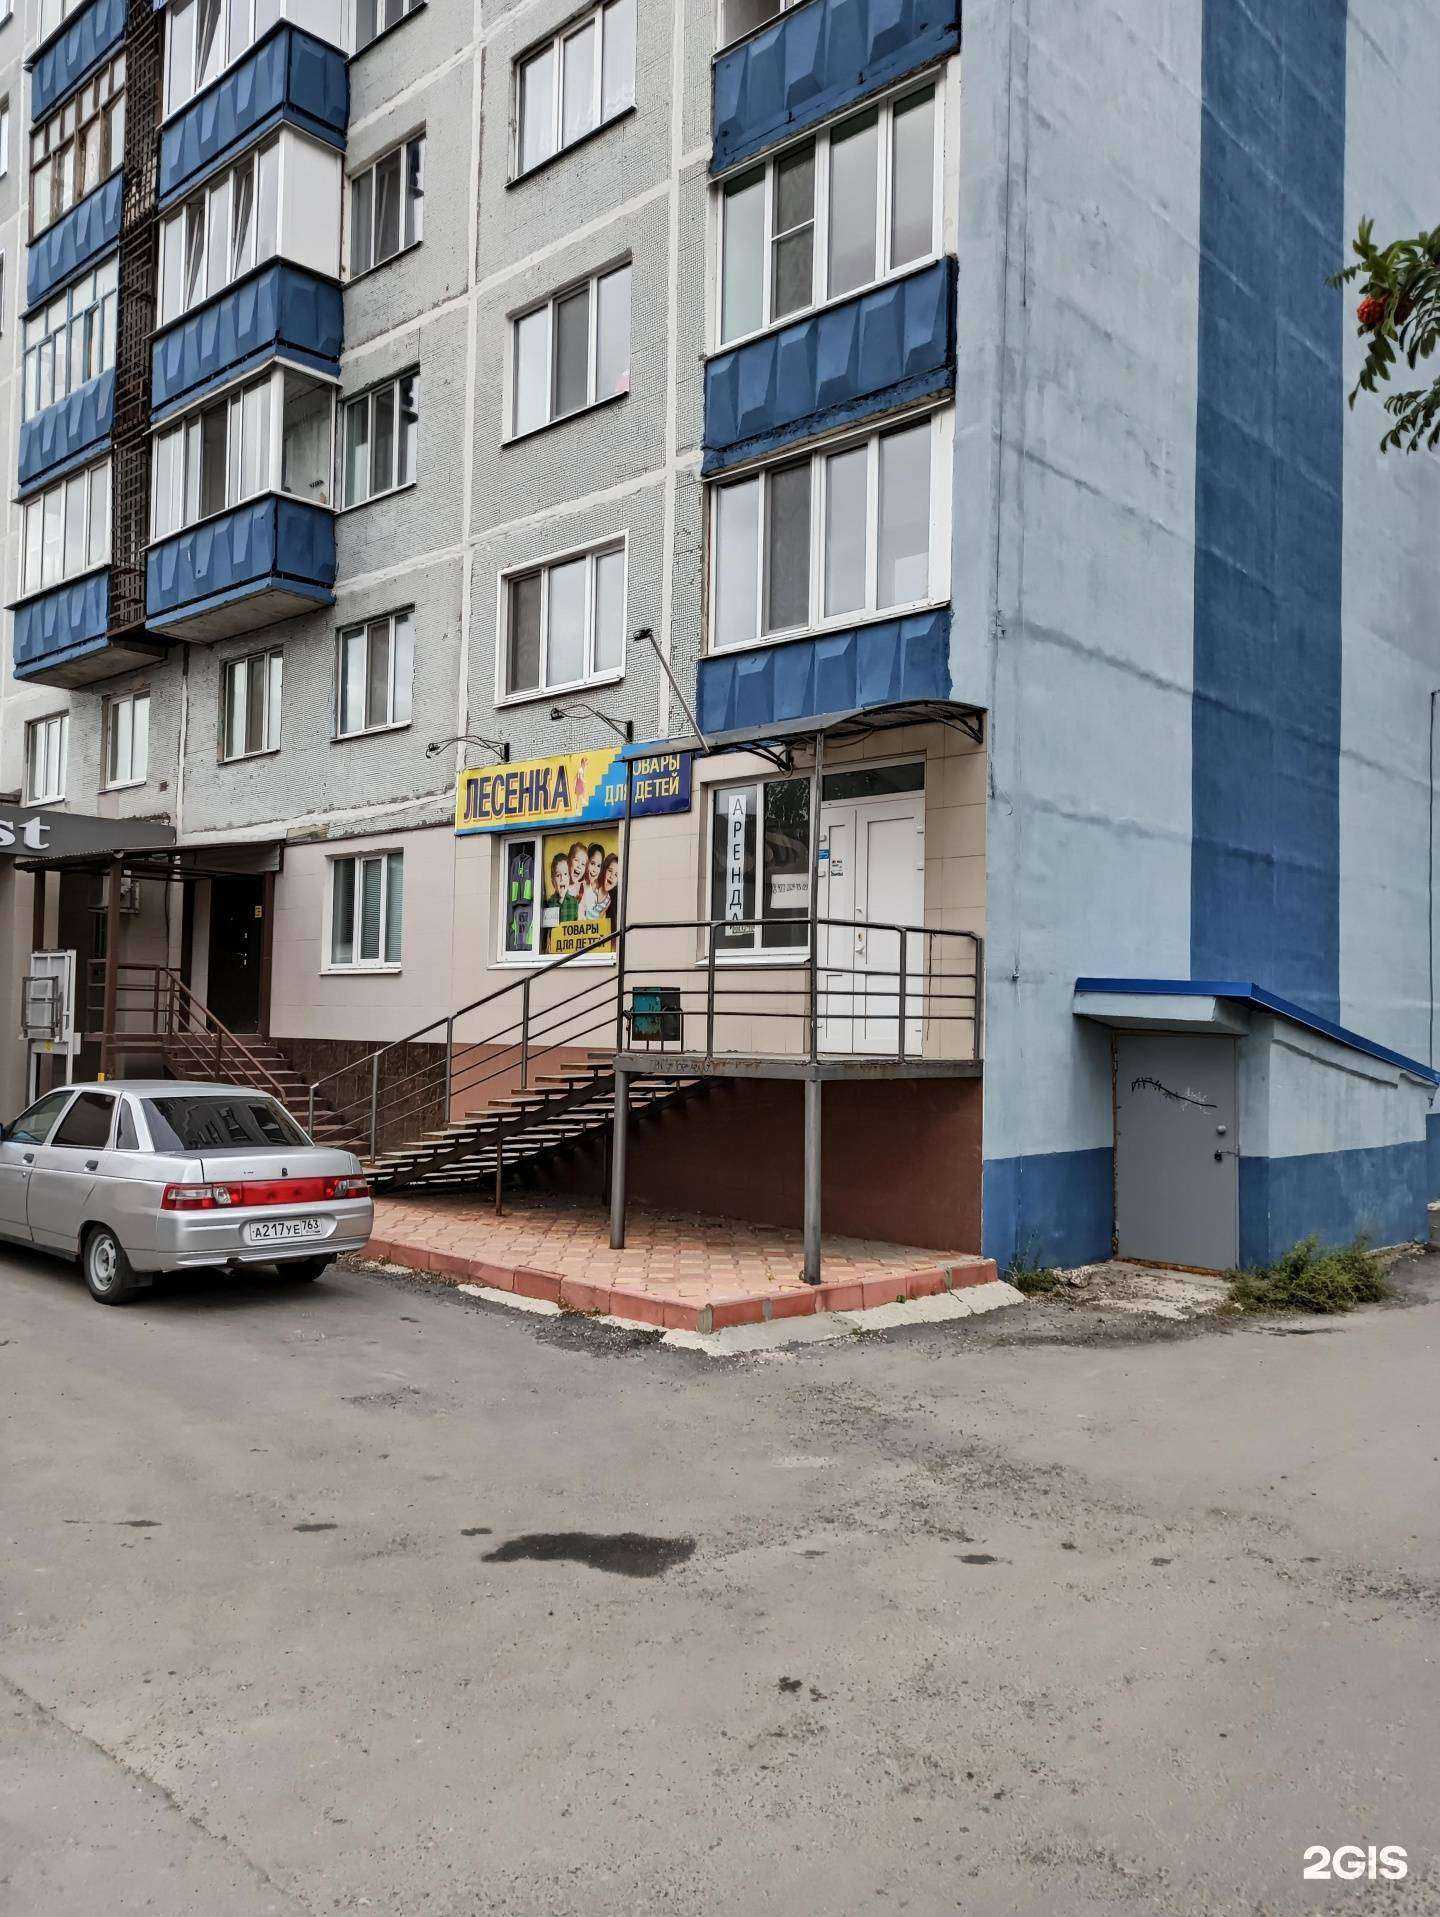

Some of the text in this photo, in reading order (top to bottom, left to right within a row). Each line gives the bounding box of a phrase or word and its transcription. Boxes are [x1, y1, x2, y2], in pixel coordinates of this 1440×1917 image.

[626, 753, 680, 776] ОВАРЫ
[464, 765, 570, 819] ЛЕСЕНКА
[634, 771, 680, 803] ДЕТЕЙ
[562, 923, 599, 936] ТОВАРЫ
[556, 938, 574, 952] ДЛЯ
[255, 1219, 319, 1238] А217УЕ 763
